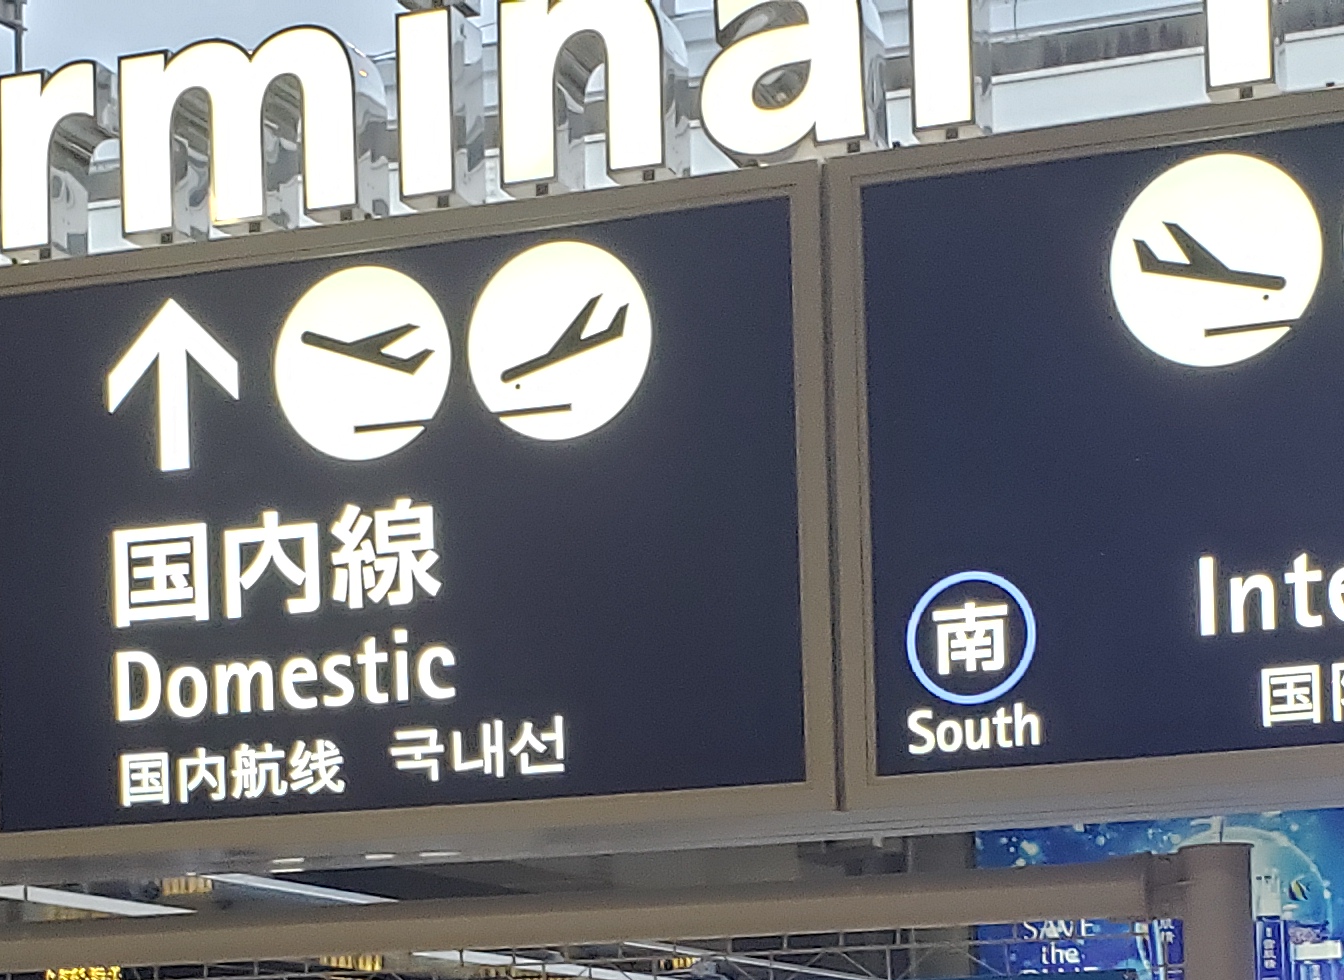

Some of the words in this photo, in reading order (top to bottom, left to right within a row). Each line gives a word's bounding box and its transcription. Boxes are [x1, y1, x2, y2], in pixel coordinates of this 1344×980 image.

[110, 498, 444, 629] 国内線
[115, 629, 457, 723] Domestic
[931, 600, 1010, 677] 南
[118, 739, 347, 808] 国内航线
[388, 714, 567, 782] 국내선
[906, 703, 1042, 757] South
[1041, 941, 1081, 965] the
